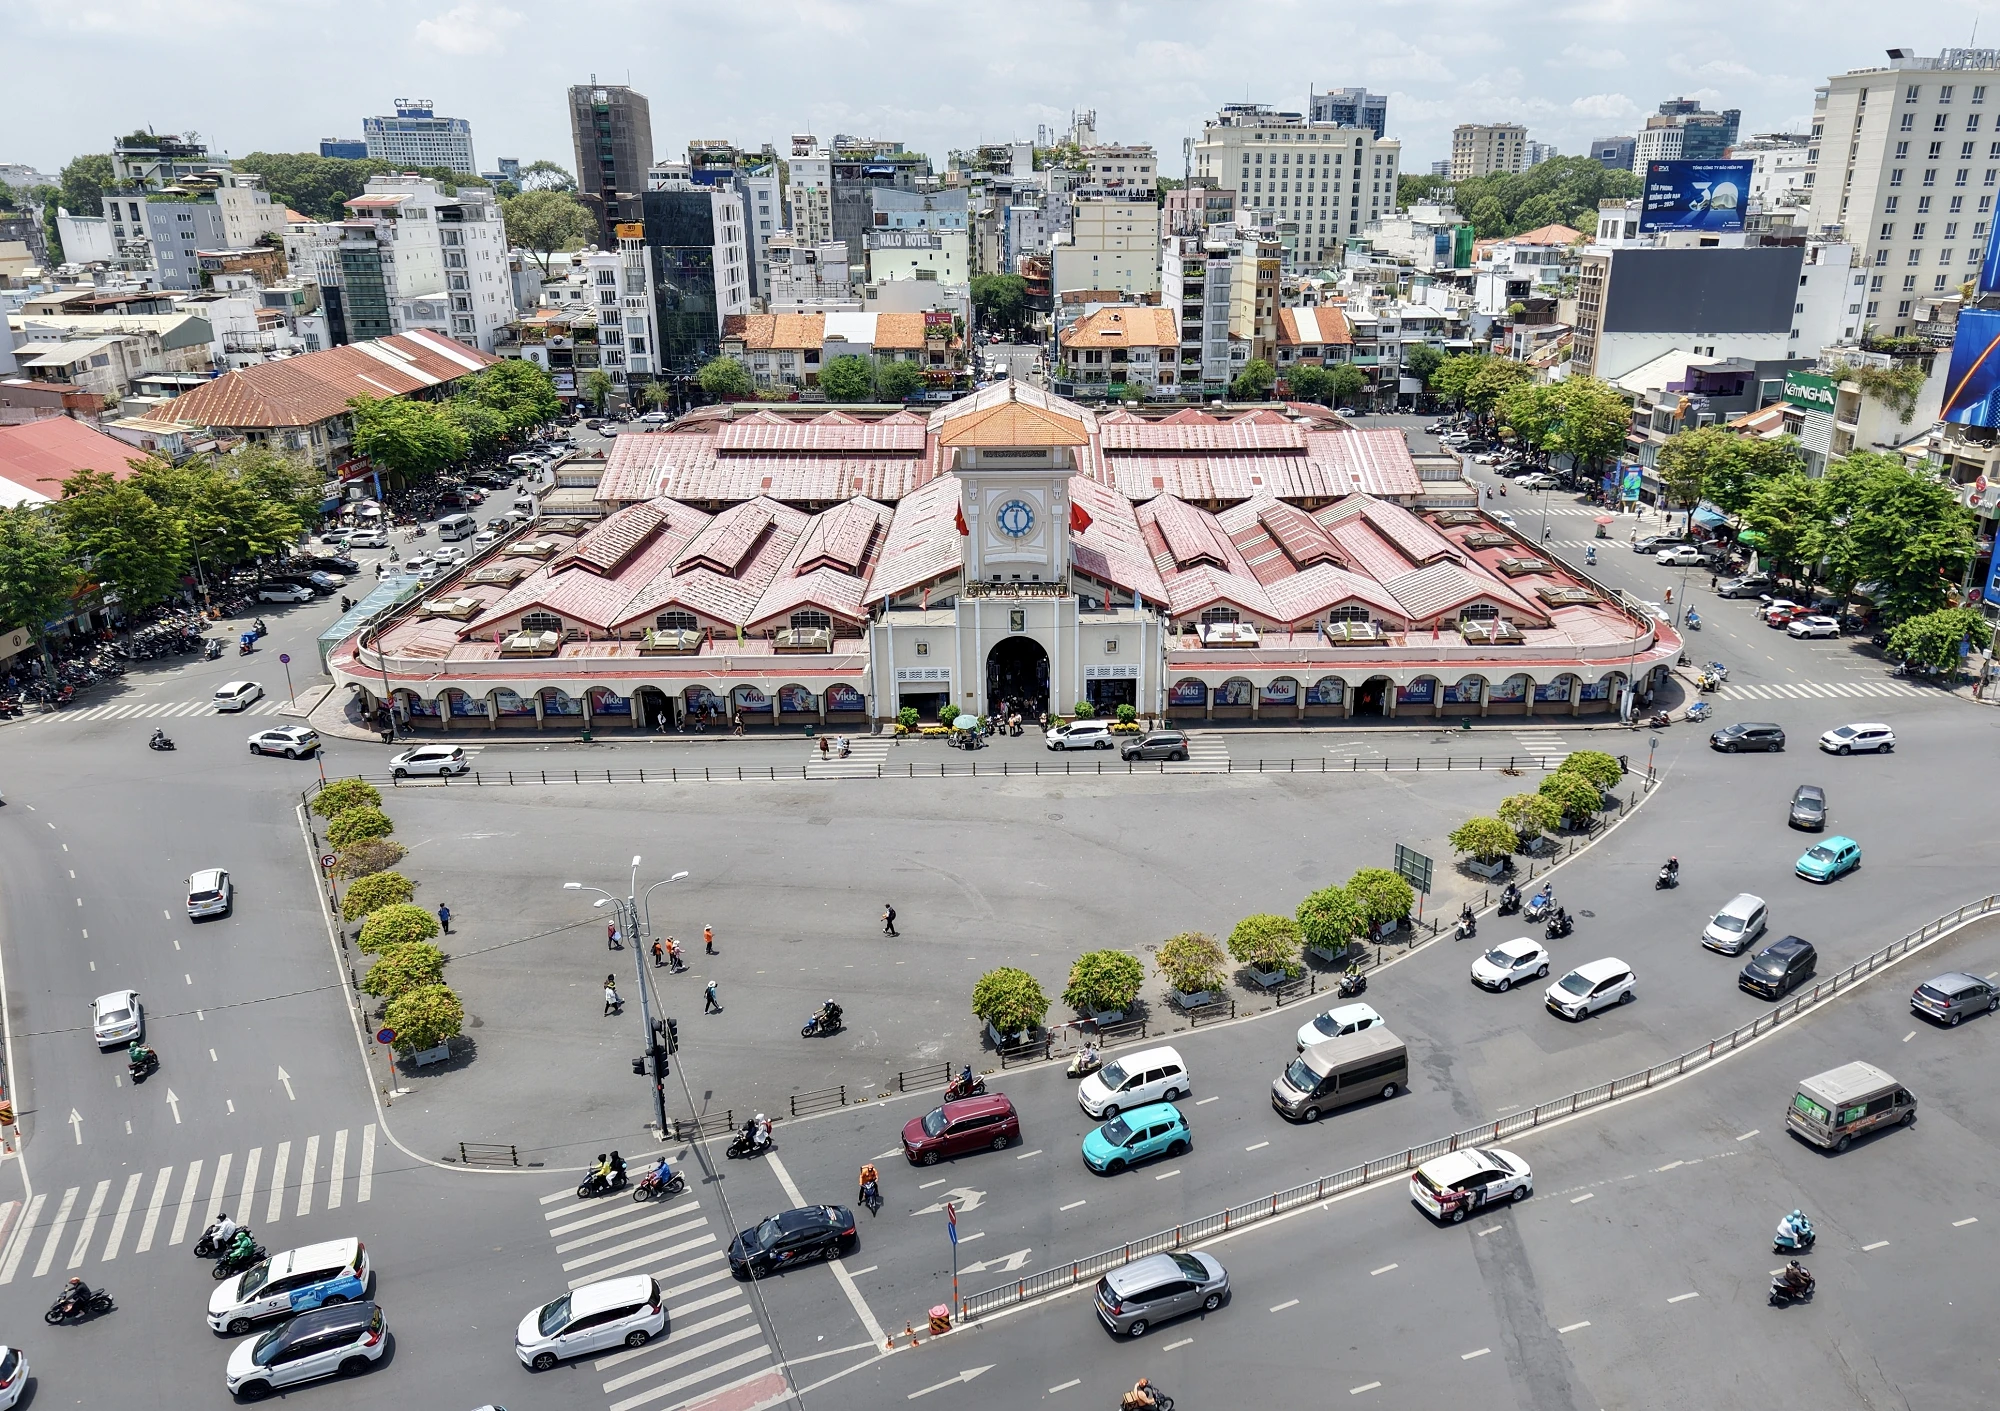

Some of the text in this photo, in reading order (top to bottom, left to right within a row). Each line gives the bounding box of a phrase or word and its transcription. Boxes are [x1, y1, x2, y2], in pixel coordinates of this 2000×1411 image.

[1689, 182, 1738, 211] 30
[880, 234, 931, 246] HALO HOTEL
[350, 460, 367, 471] VISSAN
[1024, 582, 1068, 596] THÀNH
[1174, 682, 1199, 696] Vikki
[1267, 682, 1289, 694] Vikki
[1405, 680, 1427, 692] Vikki
[597, 691, 622, 704] Vikki
[740, 690, 765, 702] Vikki
[832, 688, 857, 701] Vikki
